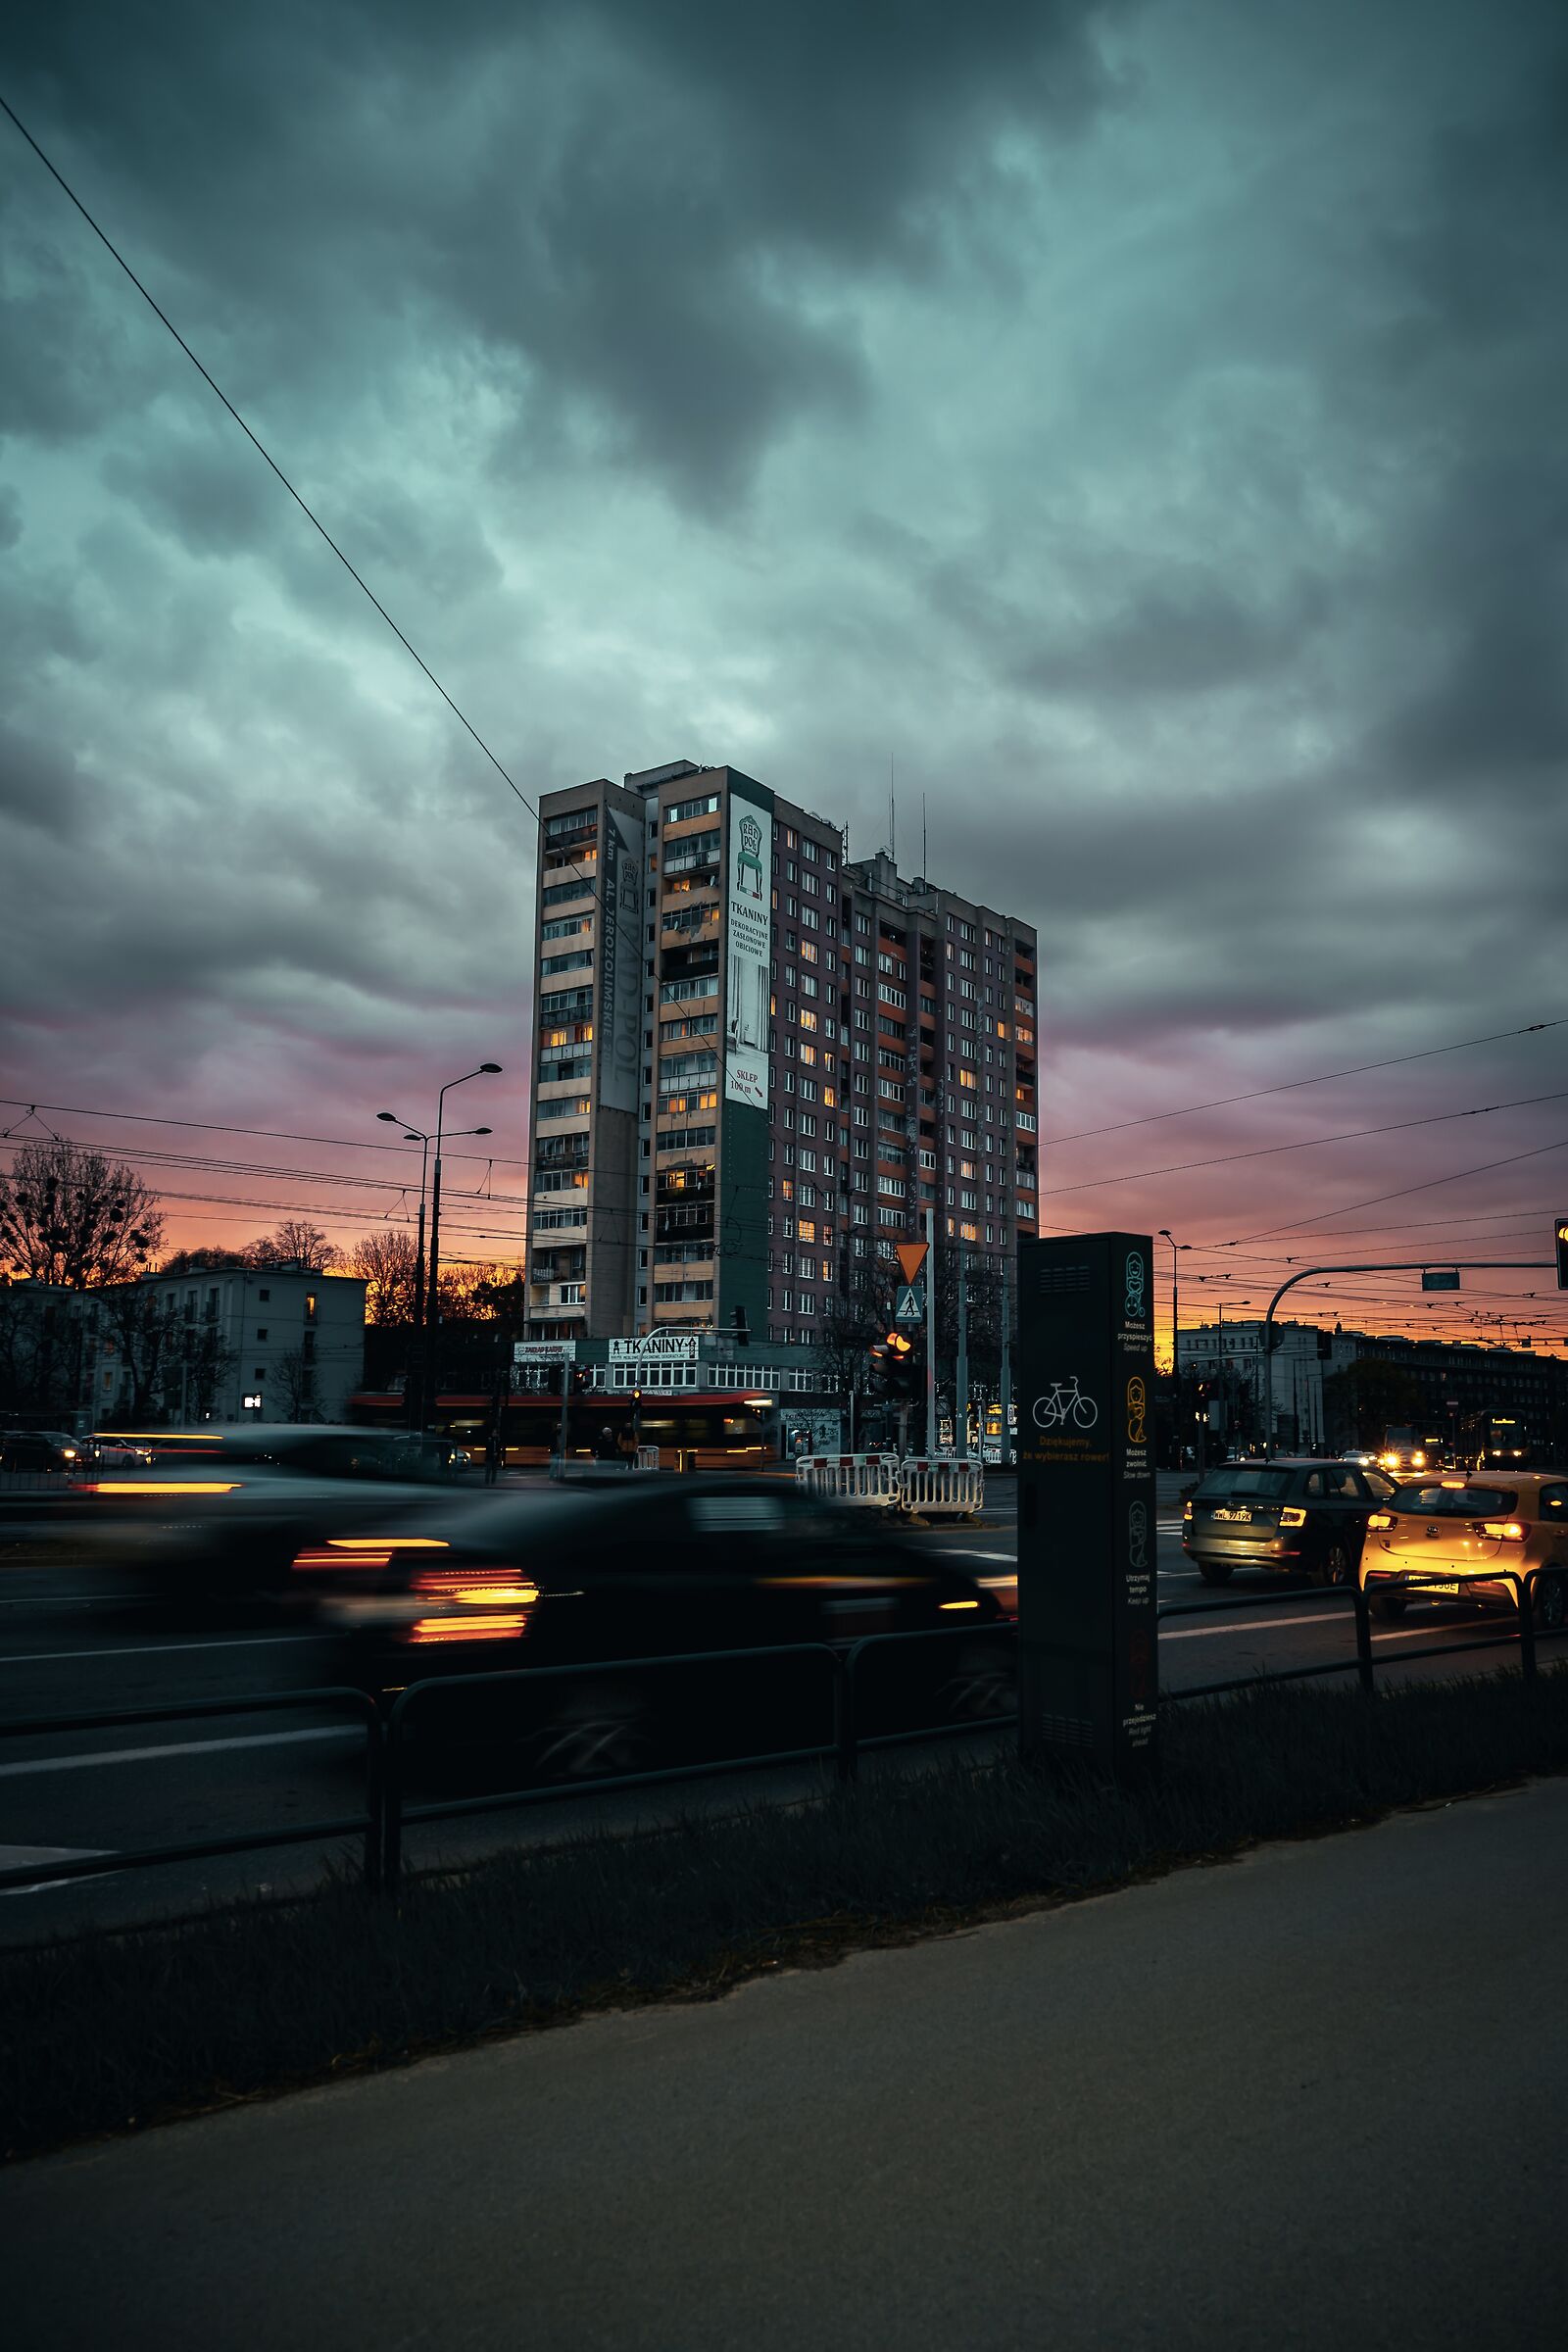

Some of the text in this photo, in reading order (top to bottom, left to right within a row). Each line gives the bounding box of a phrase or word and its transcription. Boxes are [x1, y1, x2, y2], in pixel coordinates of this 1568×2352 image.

[608, 828, 615, 860] 7 km
[606, 877, 615, 902] AL.
[730, 901, 768, 926] TKANINY
[730, 918, 768, 941] DEKORACYJNE
[732, 929, 766, 949] ZASŁONOWE
[735, 941, 763, 957] OBICIOWE
[603, 906, 615, 1036] JEROZOLIMSKIE
[614, 917, 640, 1083] RAD-POL
[736, 1069, 759, 1083] SKLEP
[730, 1080, 743, 1091] 100
[624, 1338, 684, 1353] TKANINY
[1034, 1450, 1079, 1462] wybierasz
[1229, 1511, 1250, 1521] 9719K
[1129, 1586, 1148, 1594] tempo
